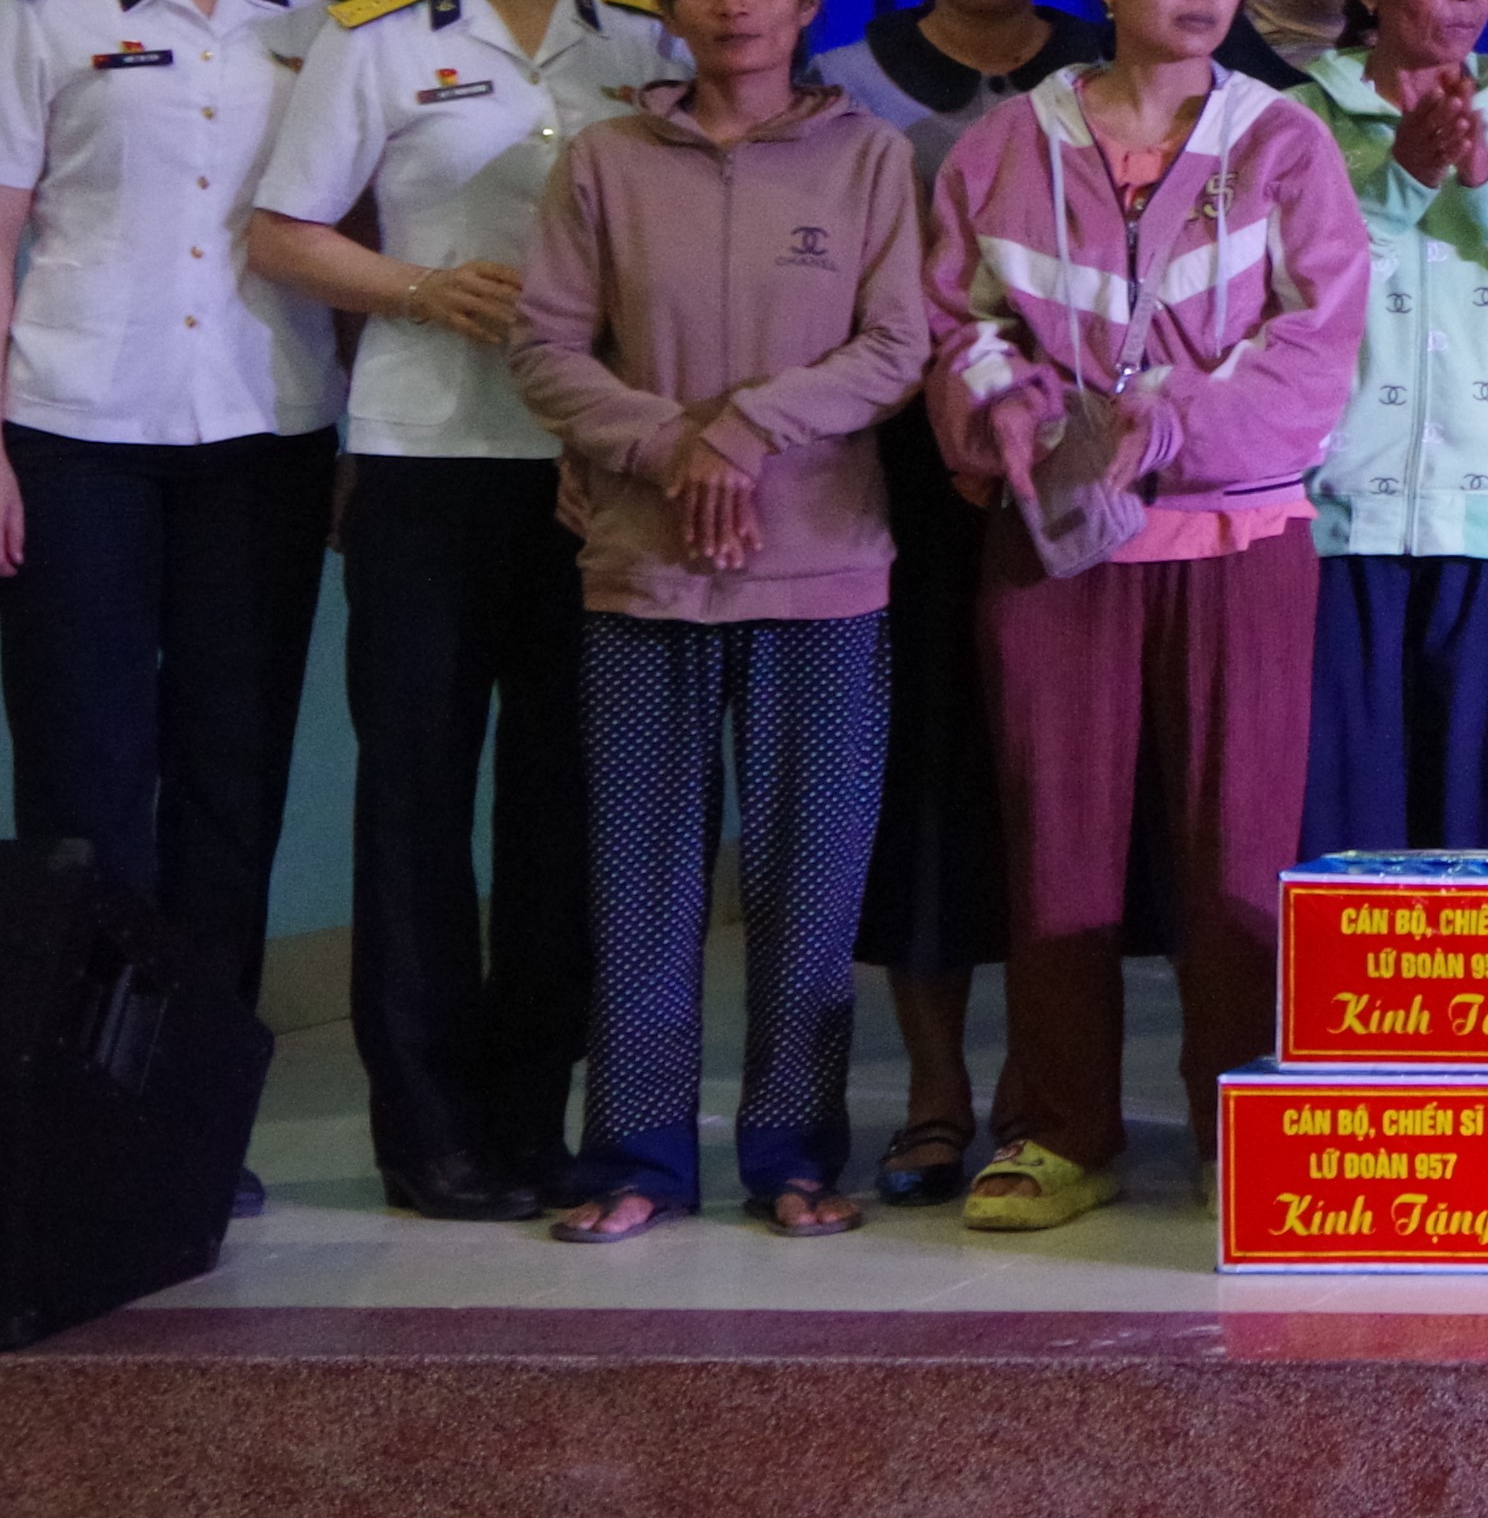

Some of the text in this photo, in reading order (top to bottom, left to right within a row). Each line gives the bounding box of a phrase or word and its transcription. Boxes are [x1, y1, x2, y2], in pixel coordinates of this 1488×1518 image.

[1341, 905, 1389, 934] CÁN
[1395, 904, 1433, 939] BỘ,
[1368, 949, 1396, 978] LỮ
[1401, 949, 1464, 978] ĐOÀN
[1333, 993, 1431, 1034] Kính
